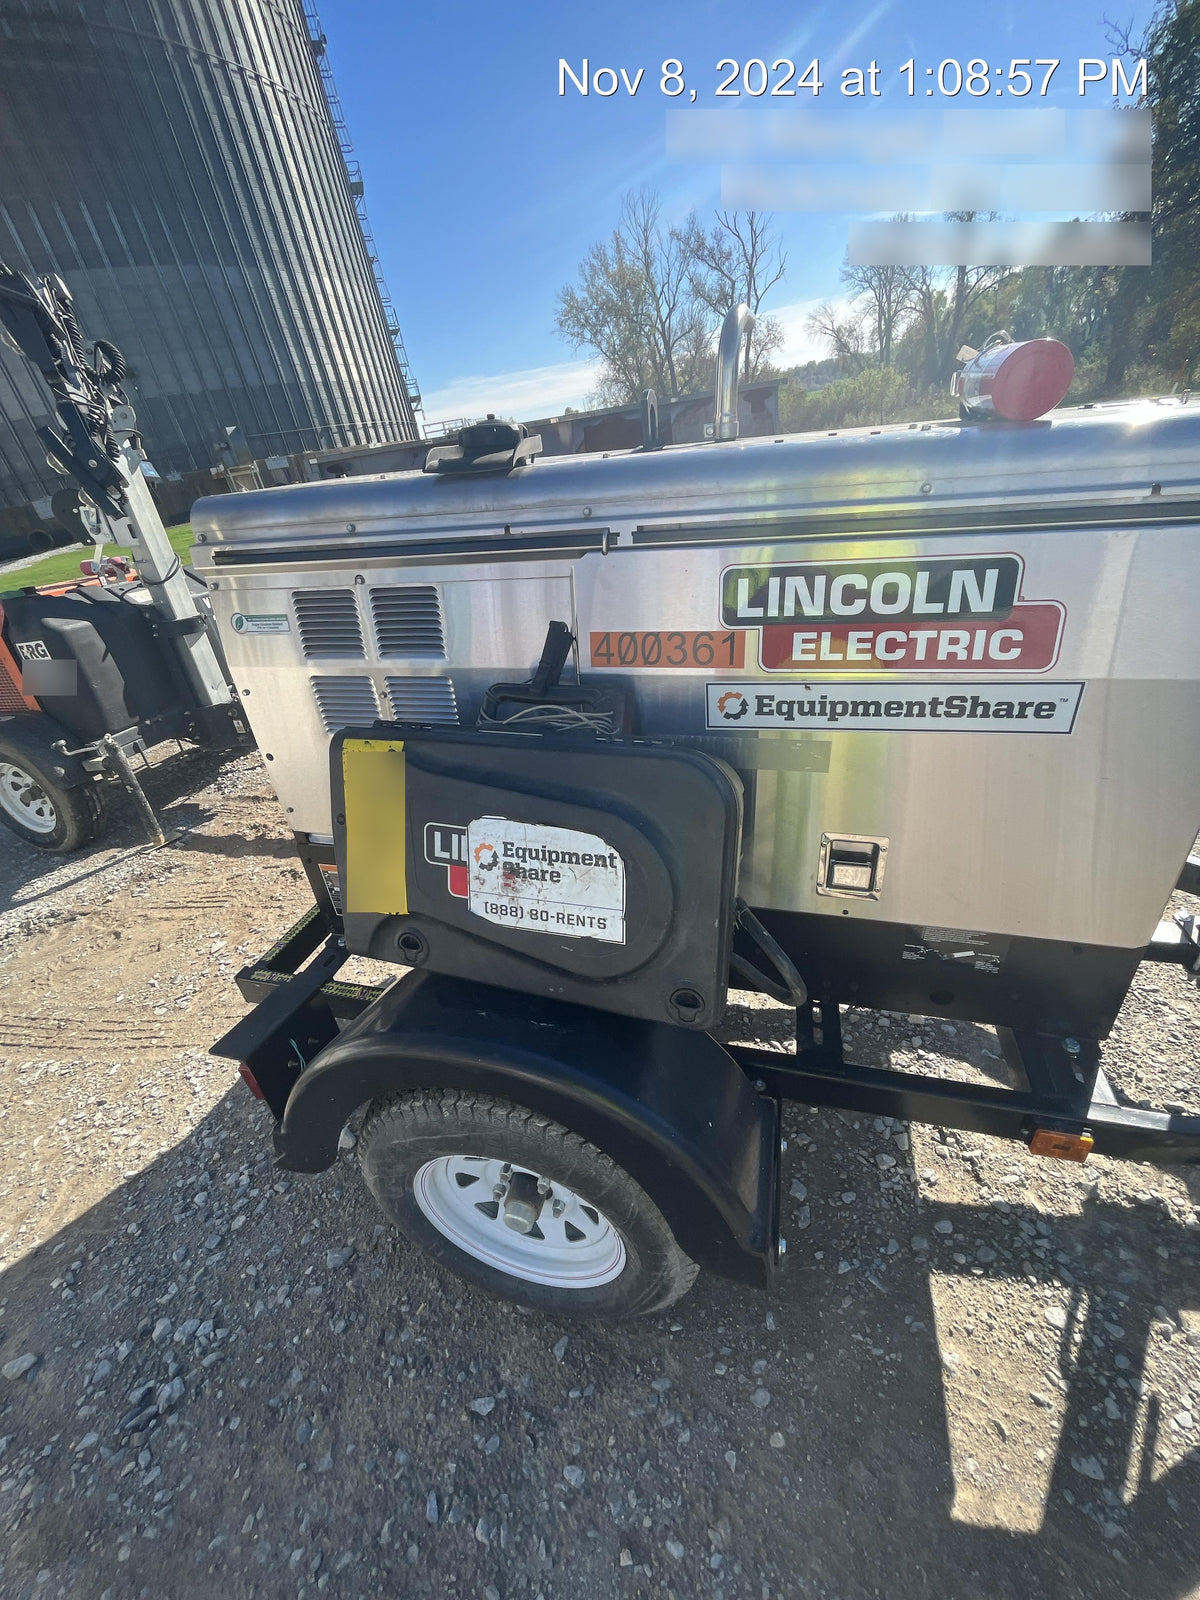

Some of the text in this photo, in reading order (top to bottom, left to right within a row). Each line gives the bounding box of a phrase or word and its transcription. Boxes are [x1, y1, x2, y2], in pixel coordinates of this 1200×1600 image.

[737, 568, 1000, 618] LINCOLN
[593, 631, 735, 666] 400361
[791, 628, 1024, 661] ELECTRIC
[755, 695, 1057, 722] EquipmentShare
[502, 841, 618, 869] Equipment
[484, 901, 607, 930] (888) 80-RENTS
